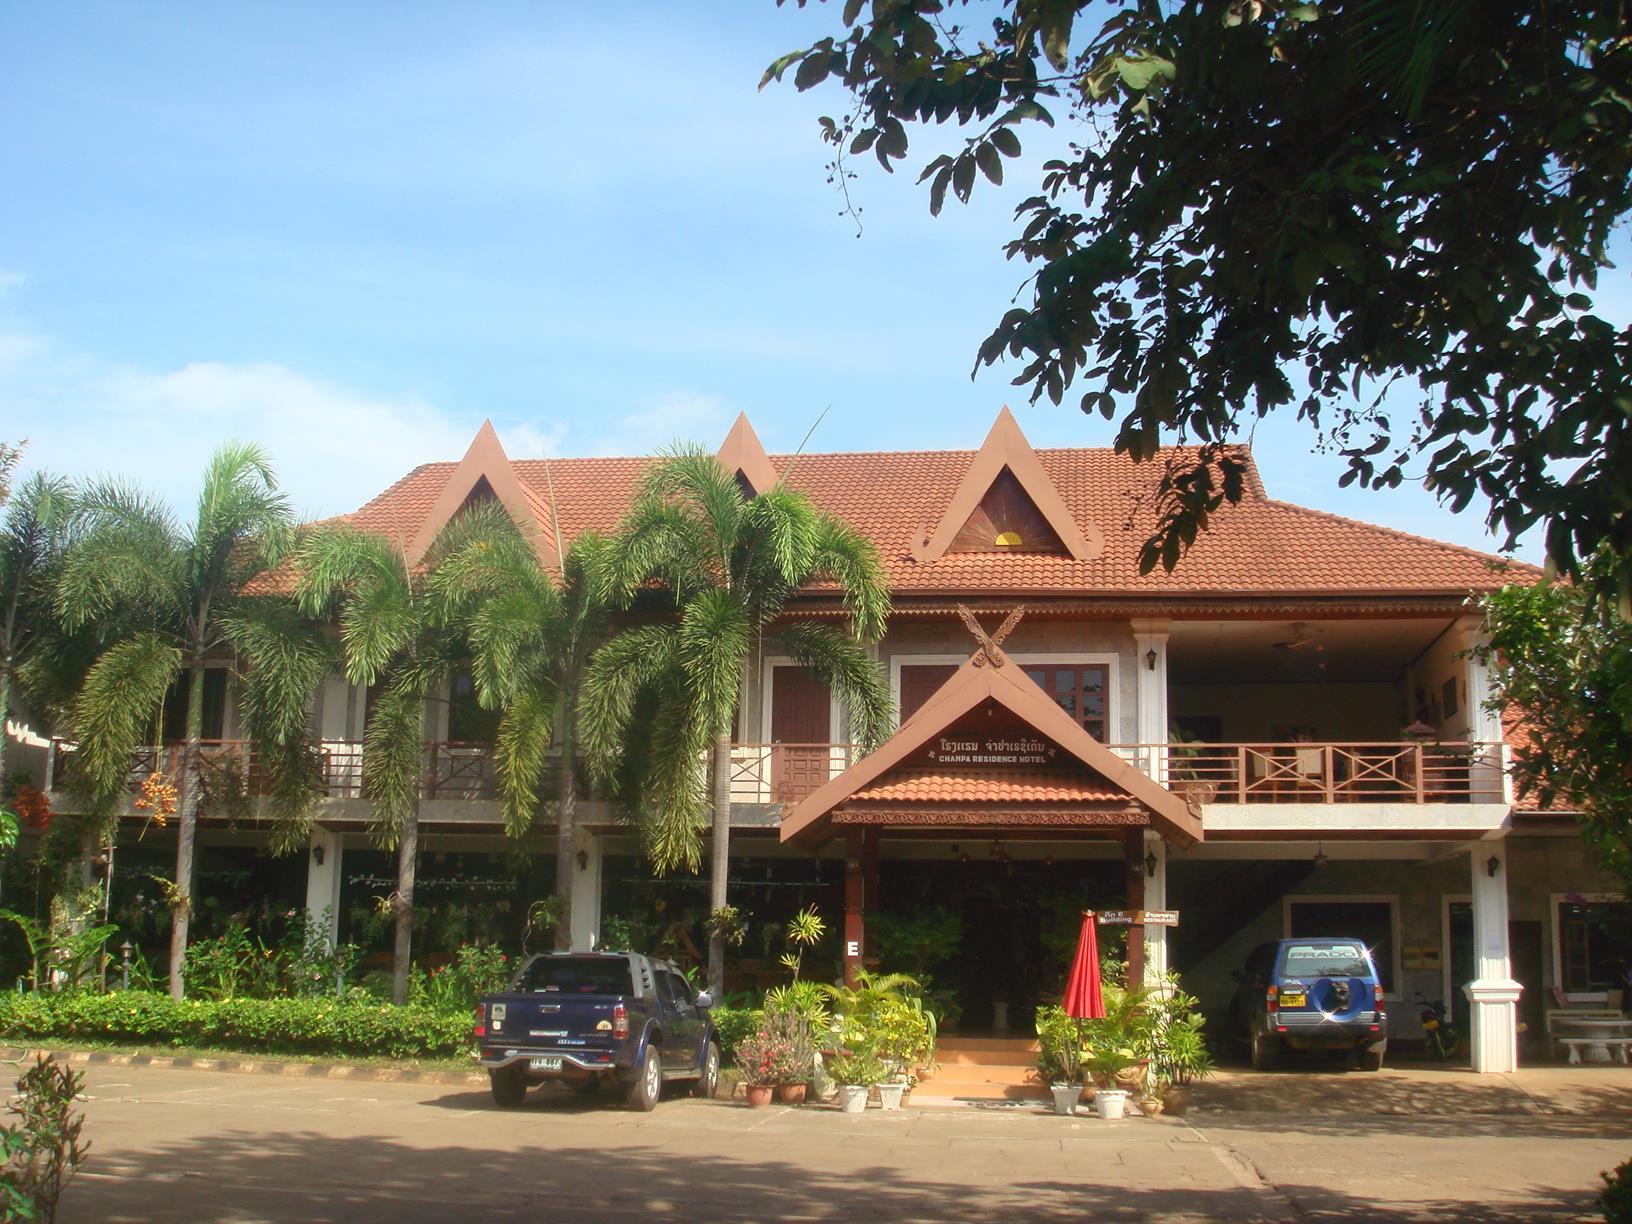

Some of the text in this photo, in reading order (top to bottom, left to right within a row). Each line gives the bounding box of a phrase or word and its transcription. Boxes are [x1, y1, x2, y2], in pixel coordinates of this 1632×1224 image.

[939, 755, 1047, 764] CHAMPA RESIDENCE HOTEL
[848, 941, 858, 956] E
